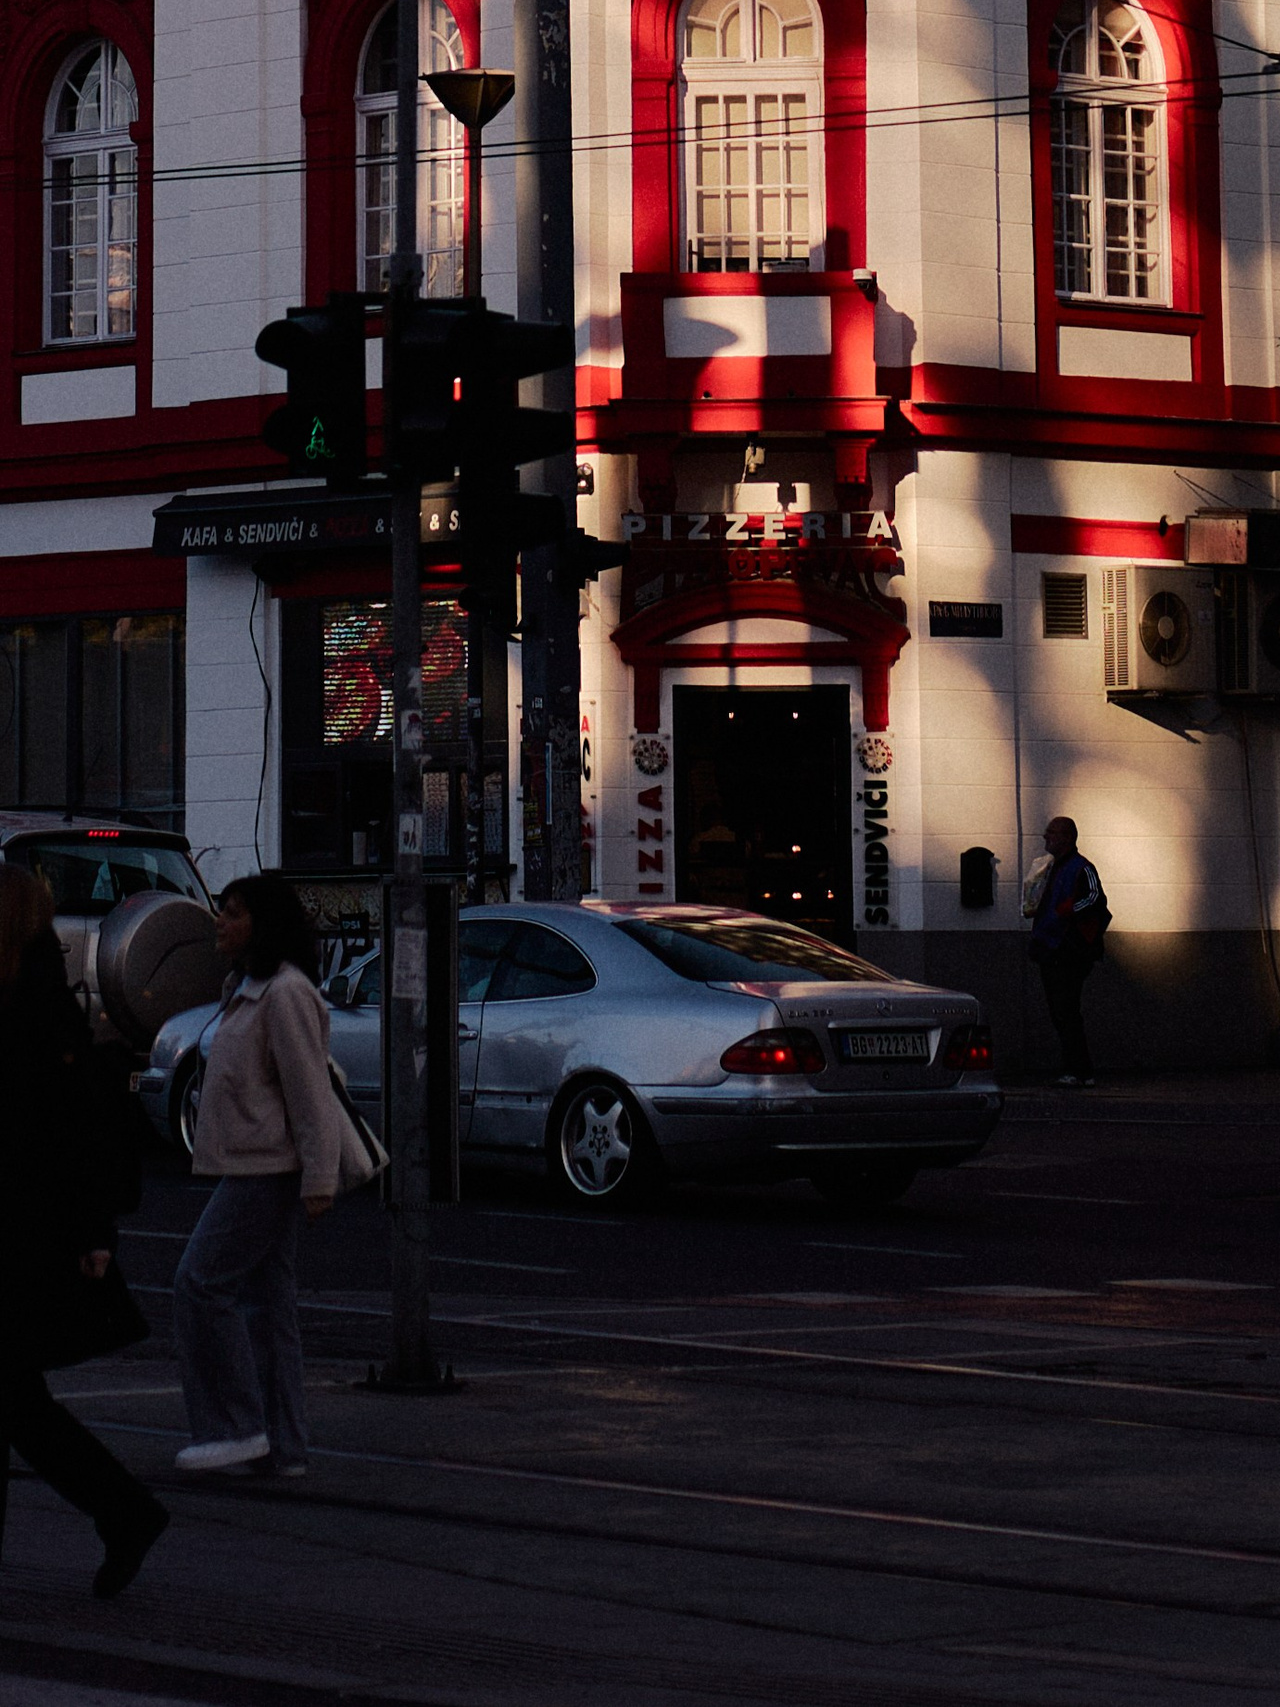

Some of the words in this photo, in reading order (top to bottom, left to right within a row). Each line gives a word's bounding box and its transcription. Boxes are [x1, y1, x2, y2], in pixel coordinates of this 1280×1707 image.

[181, 524, 218, 547] KAFA
[224, 528, 234, 543] &
[238, 515, 304, 543] SENDVIČI
[309, 522, 319, 539] &
[375, 517, 385, 533] &
[429, 513, 440, 531] &
[622, 510, 893, 541] PIZZERIA
[857, 780, 889, 925] SENDVIČI
[851, 1036, 867, 1055] BG
